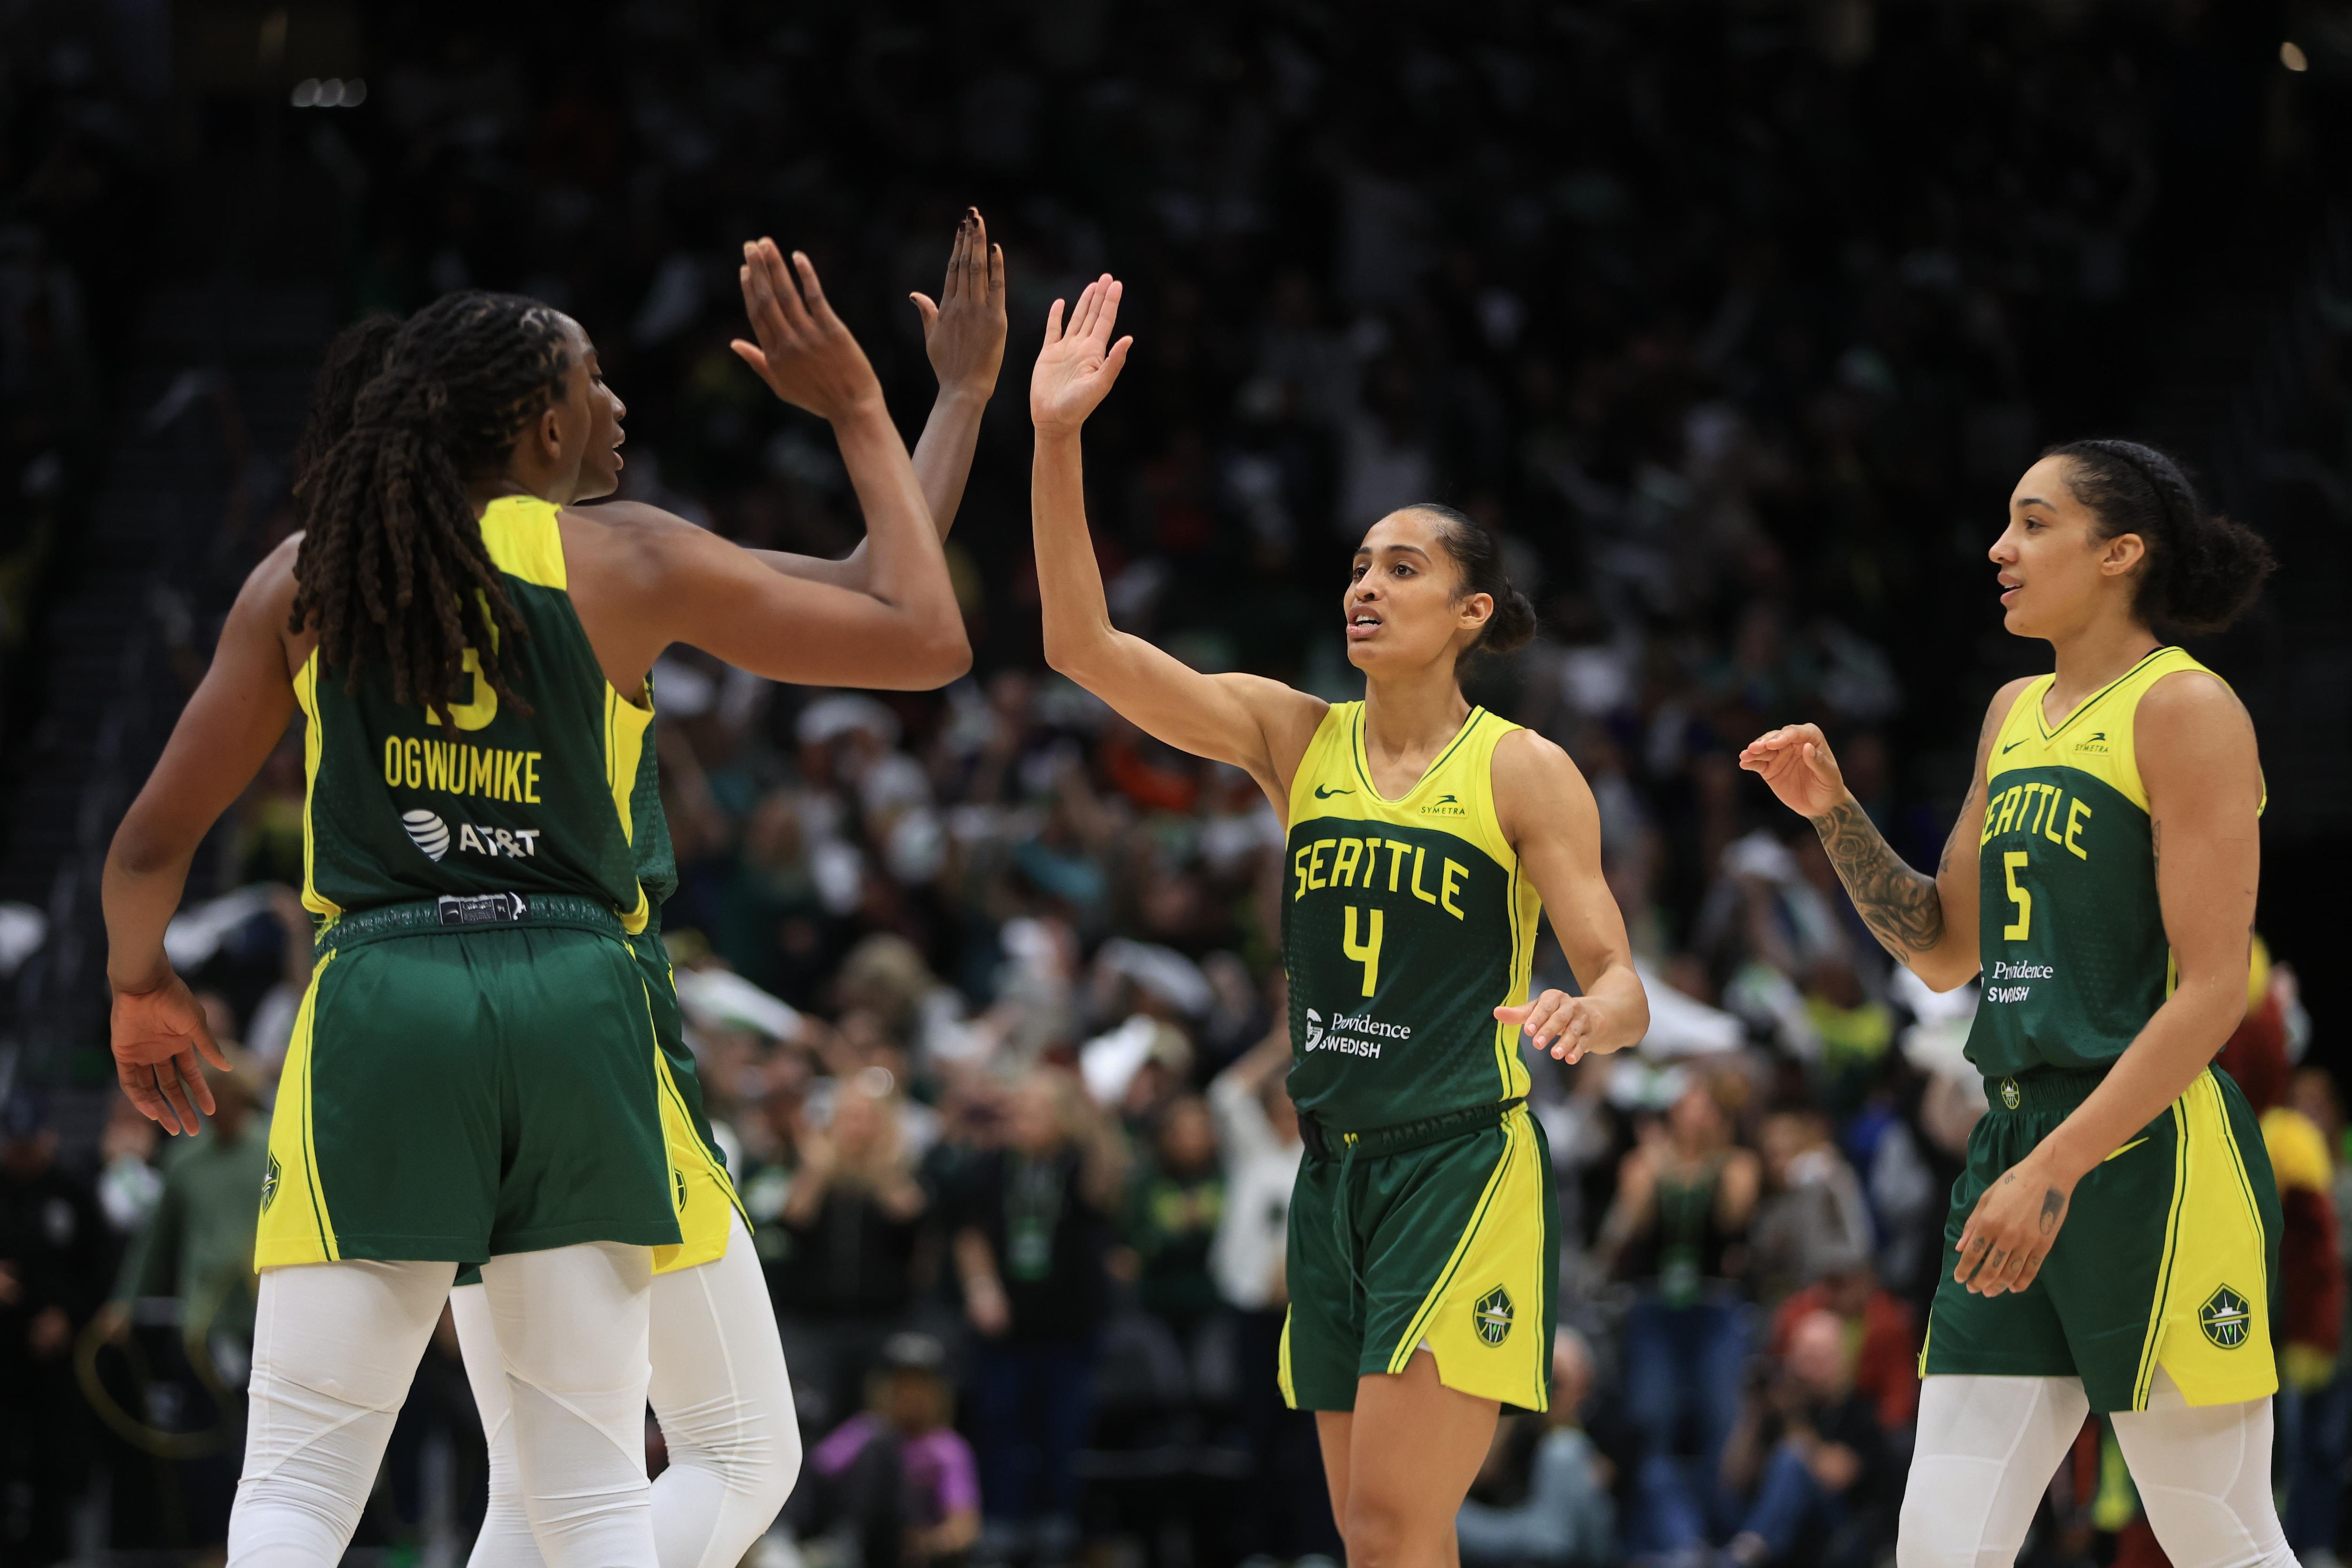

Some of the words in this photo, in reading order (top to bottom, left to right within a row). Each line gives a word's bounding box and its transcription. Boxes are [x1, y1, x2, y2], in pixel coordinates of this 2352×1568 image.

[2075, 744, 2108, 753] SYMETRA
[385, 735, 542, 804] OGWUMIKE
[1421, 806, 1466, 815] SYMETRA
[460, 823, 540, 858] AT&T
[1295, 837, 1469, 921] SEATTLE
[2004, 851, 2032, 940] 5
[1343, 905, 1383, 997] 4
[1987, 986, 2030, 1003] SWDISH
[1319, 1035, 1381, 1059] SWEDISH
